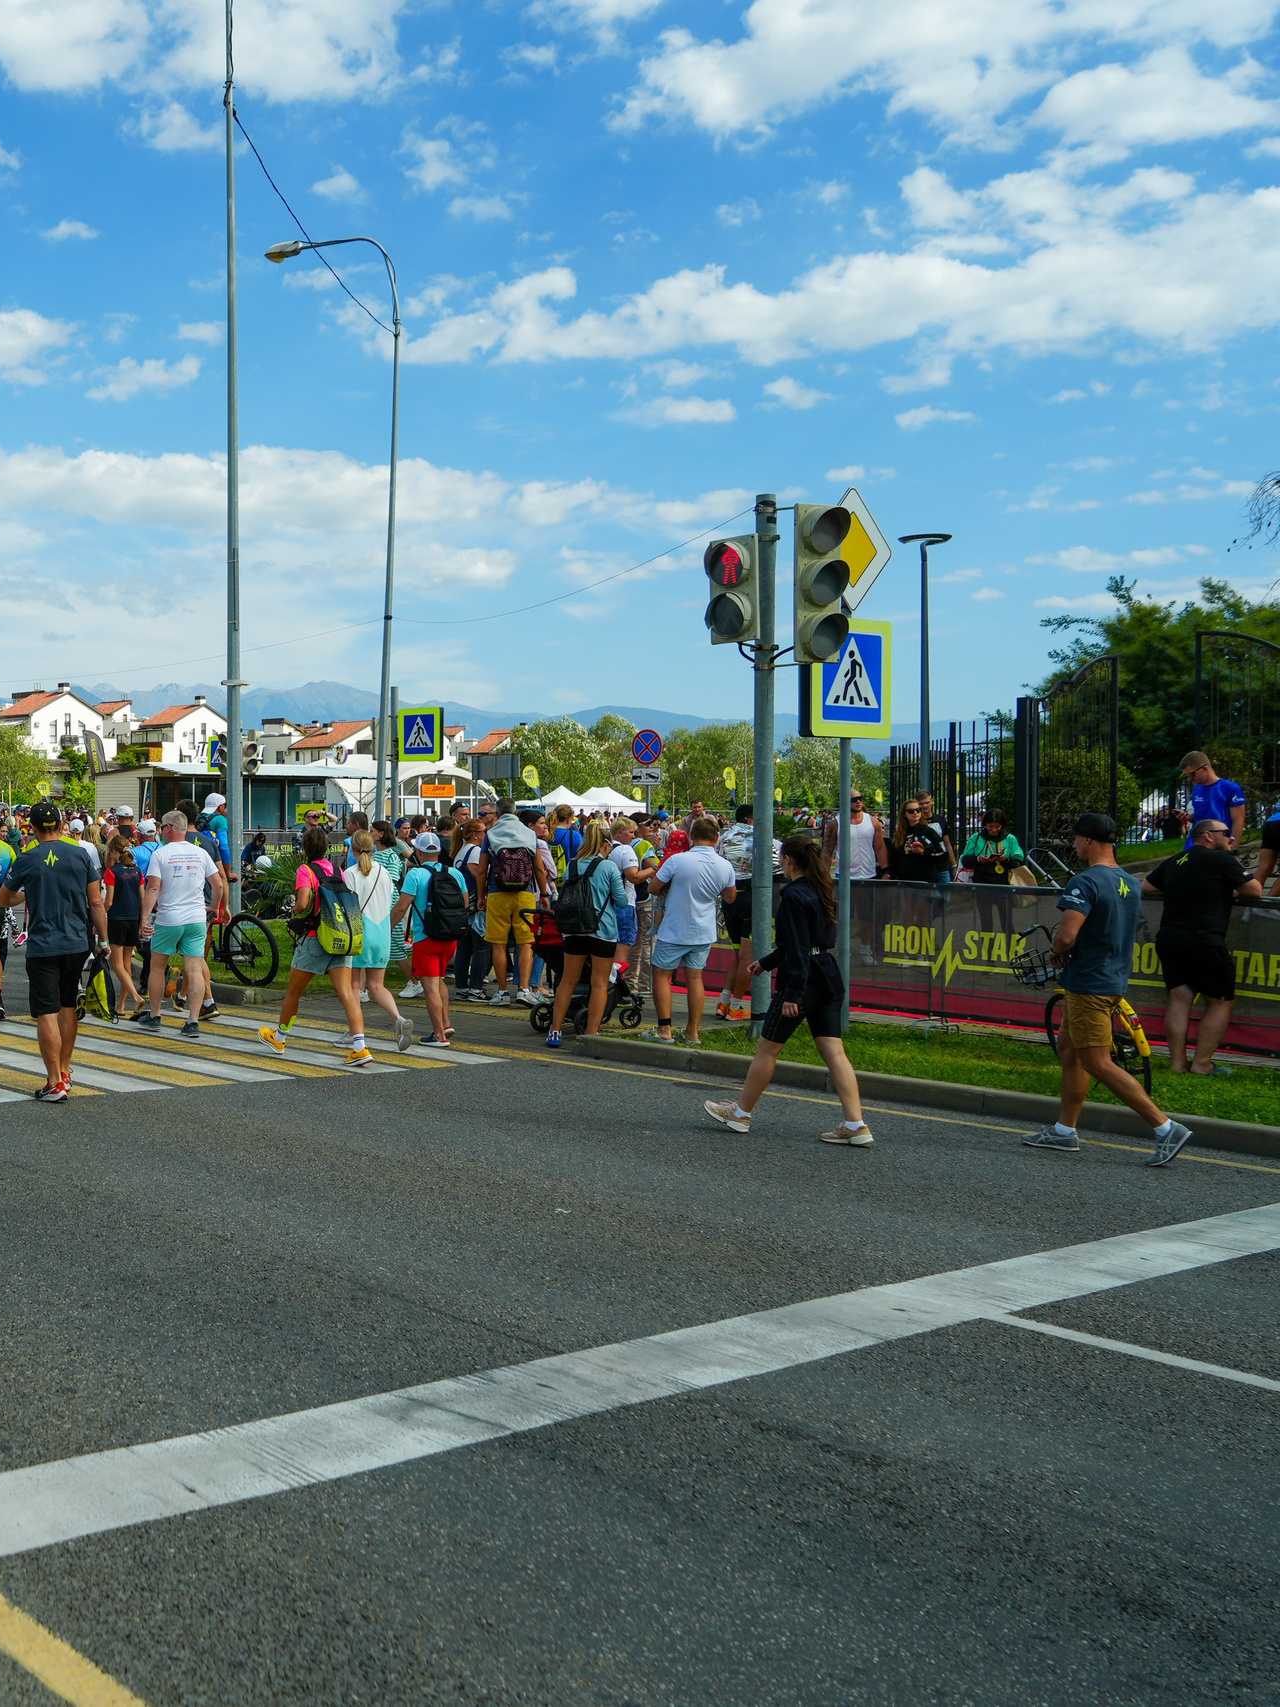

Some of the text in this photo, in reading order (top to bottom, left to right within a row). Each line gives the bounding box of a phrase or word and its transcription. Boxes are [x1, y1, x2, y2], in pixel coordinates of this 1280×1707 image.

[332, 942, 346, 950] STAR
[884, 924, 1027, 963] IRON STAR
[1132, 942, 1280, 988] RO TAR
